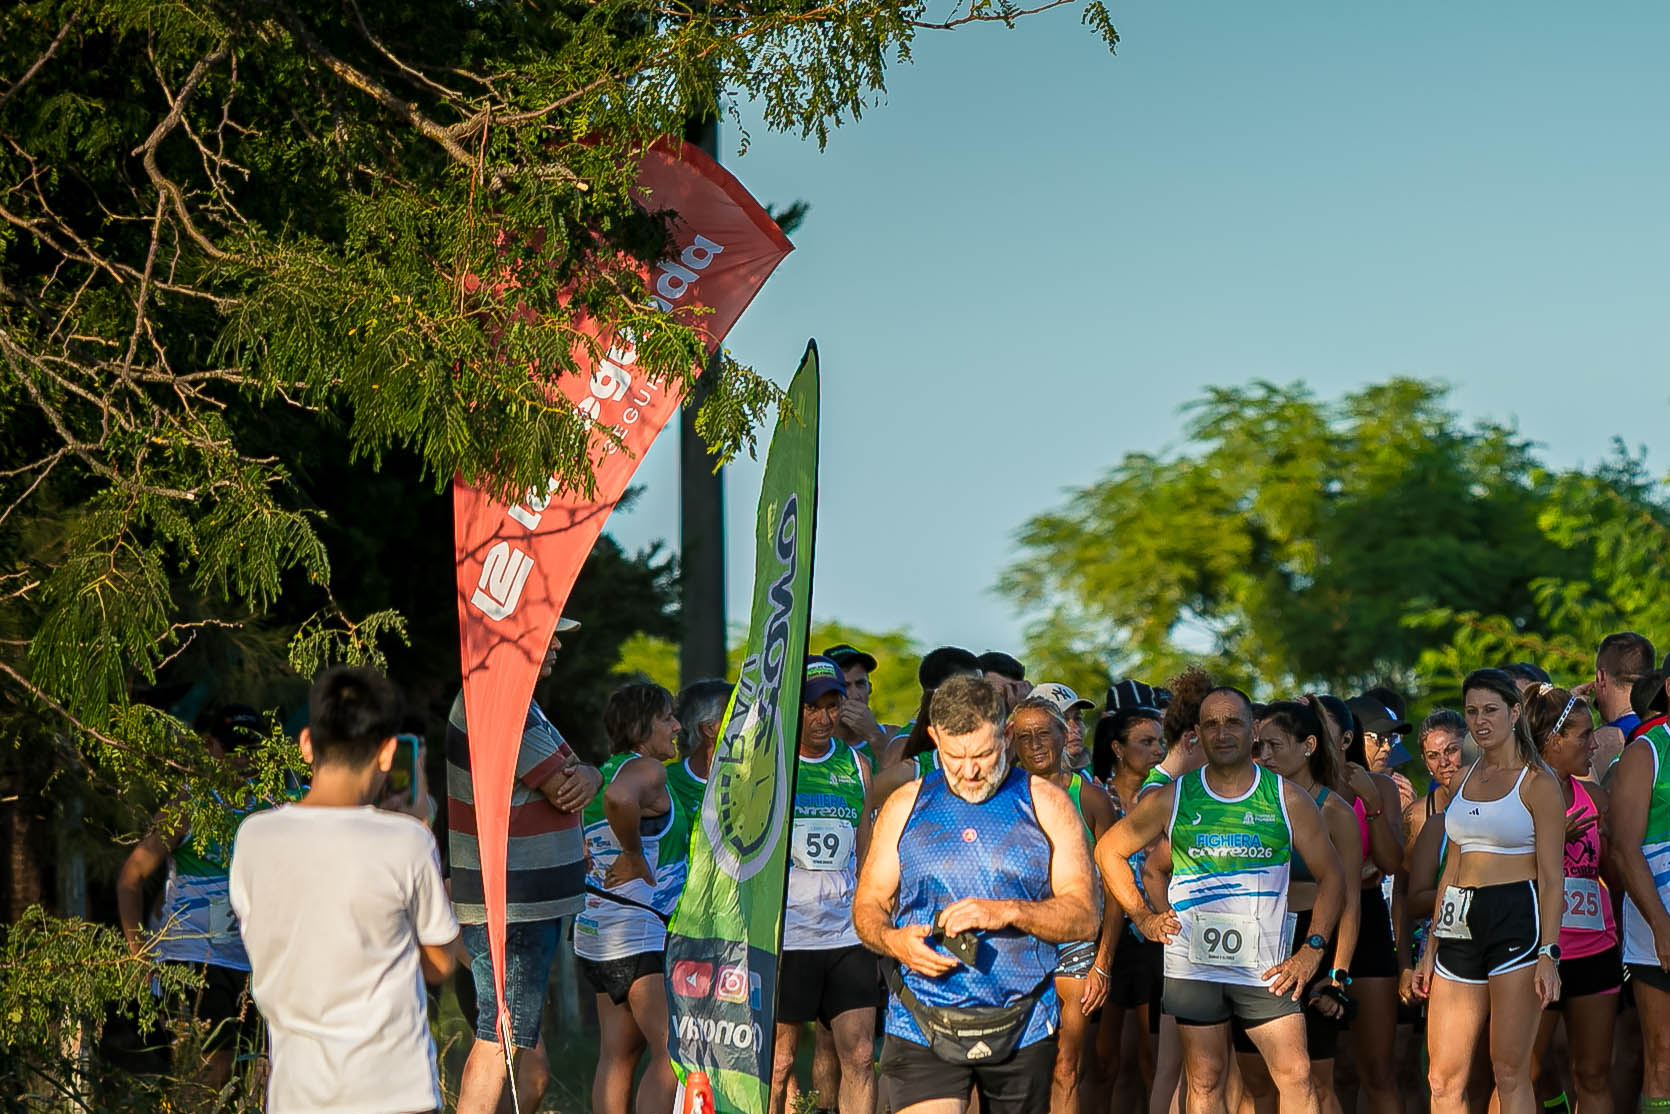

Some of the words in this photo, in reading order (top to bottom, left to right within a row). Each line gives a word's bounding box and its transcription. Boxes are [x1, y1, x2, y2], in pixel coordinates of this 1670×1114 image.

[560, 233, 724, 455] eguda
[806, 832, 840, 858] 59
[1196, 833, 1262, 848] FIGHIERA
[1203, 927, 1243, 955] 90
